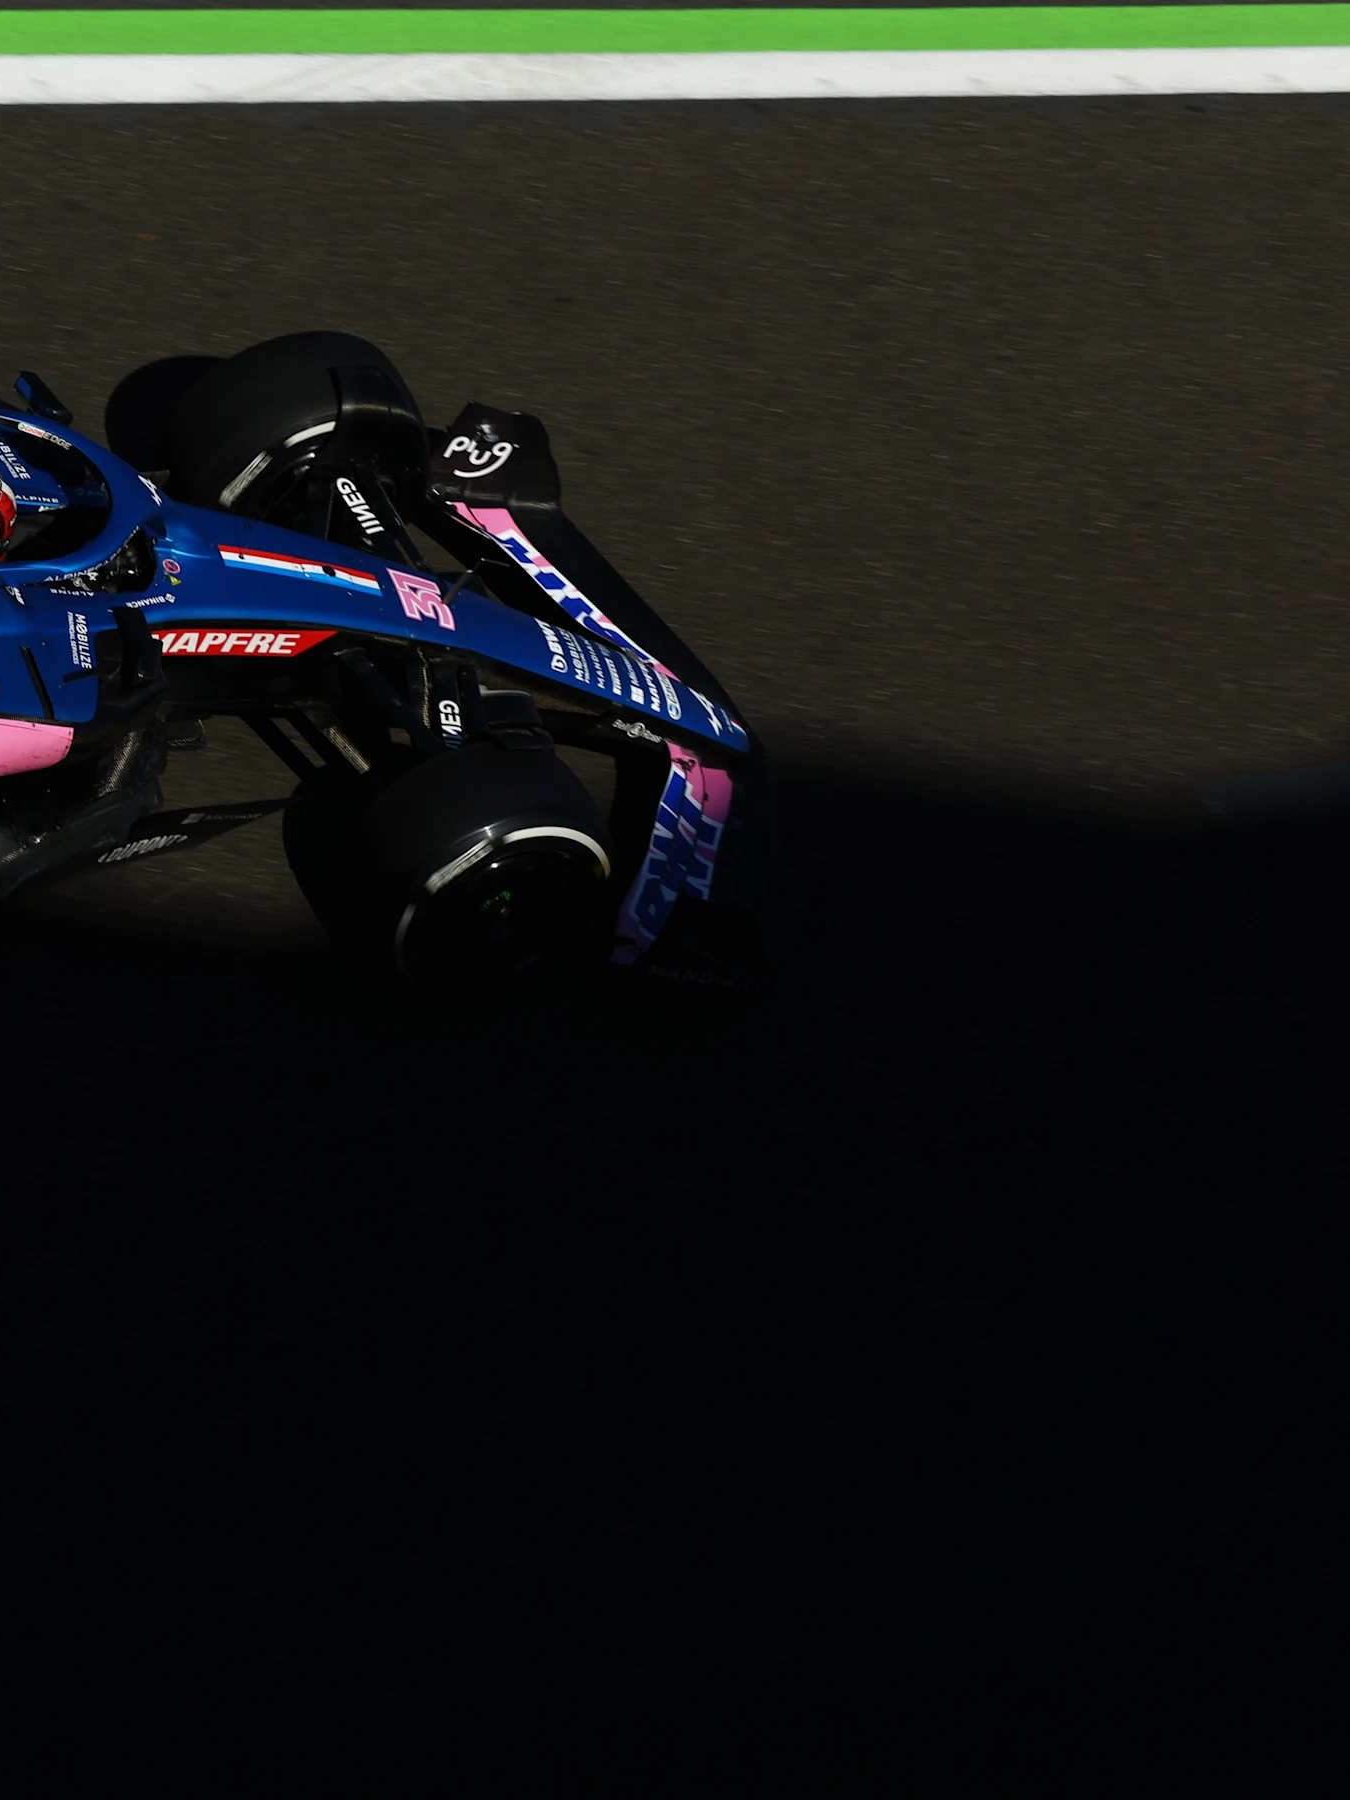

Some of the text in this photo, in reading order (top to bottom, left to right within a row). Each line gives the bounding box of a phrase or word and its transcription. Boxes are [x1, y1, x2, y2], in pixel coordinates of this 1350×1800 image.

[44, 431, 71, 450] EDGE
[15, 493, 60, 504] ALPINE
[385, 567, 456, 632] 31
[103, 834, 183, 863] DUPONT
